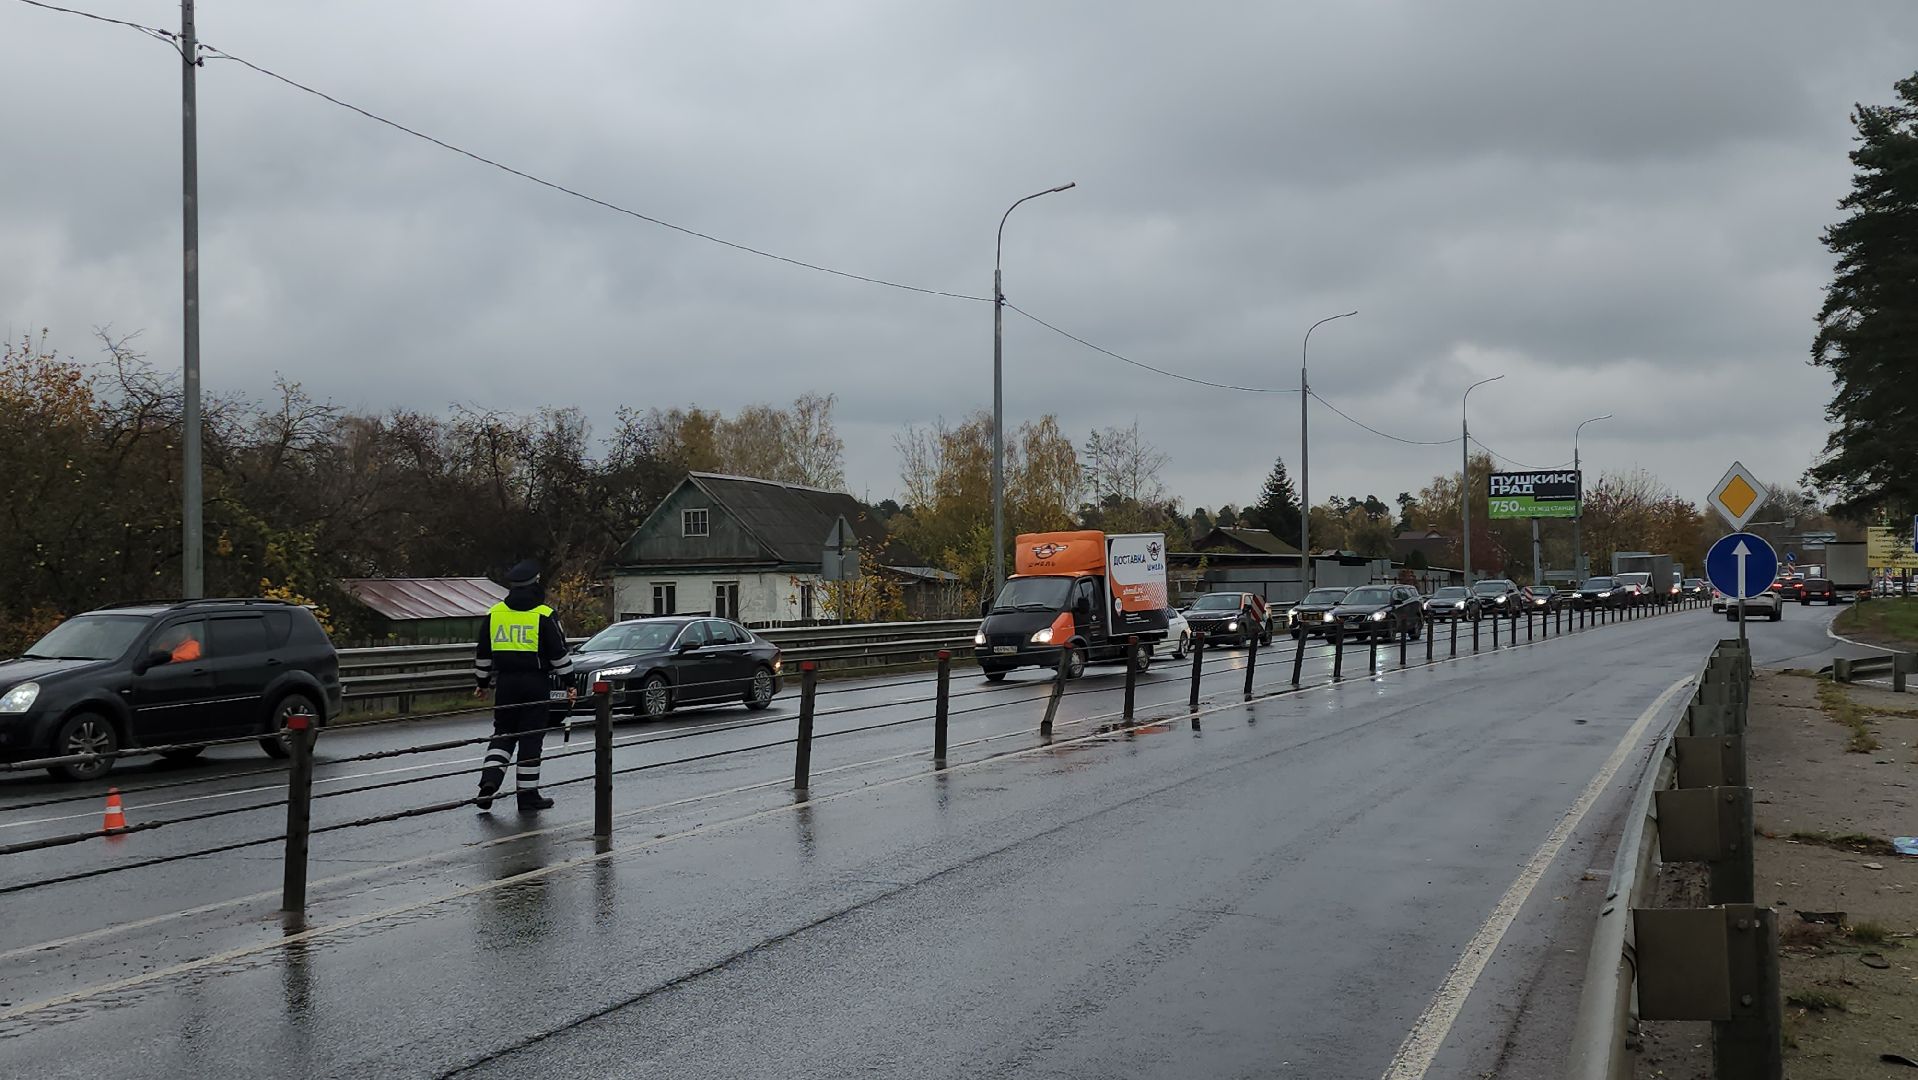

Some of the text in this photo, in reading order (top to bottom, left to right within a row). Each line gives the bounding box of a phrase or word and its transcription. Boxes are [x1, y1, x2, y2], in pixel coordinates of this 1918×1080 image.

[1490, 485, 1535, 495] ГРАД
[1113, 554, 1146, 566] ДОСТАВКА
[494, 624, 534, 644] ДПС
